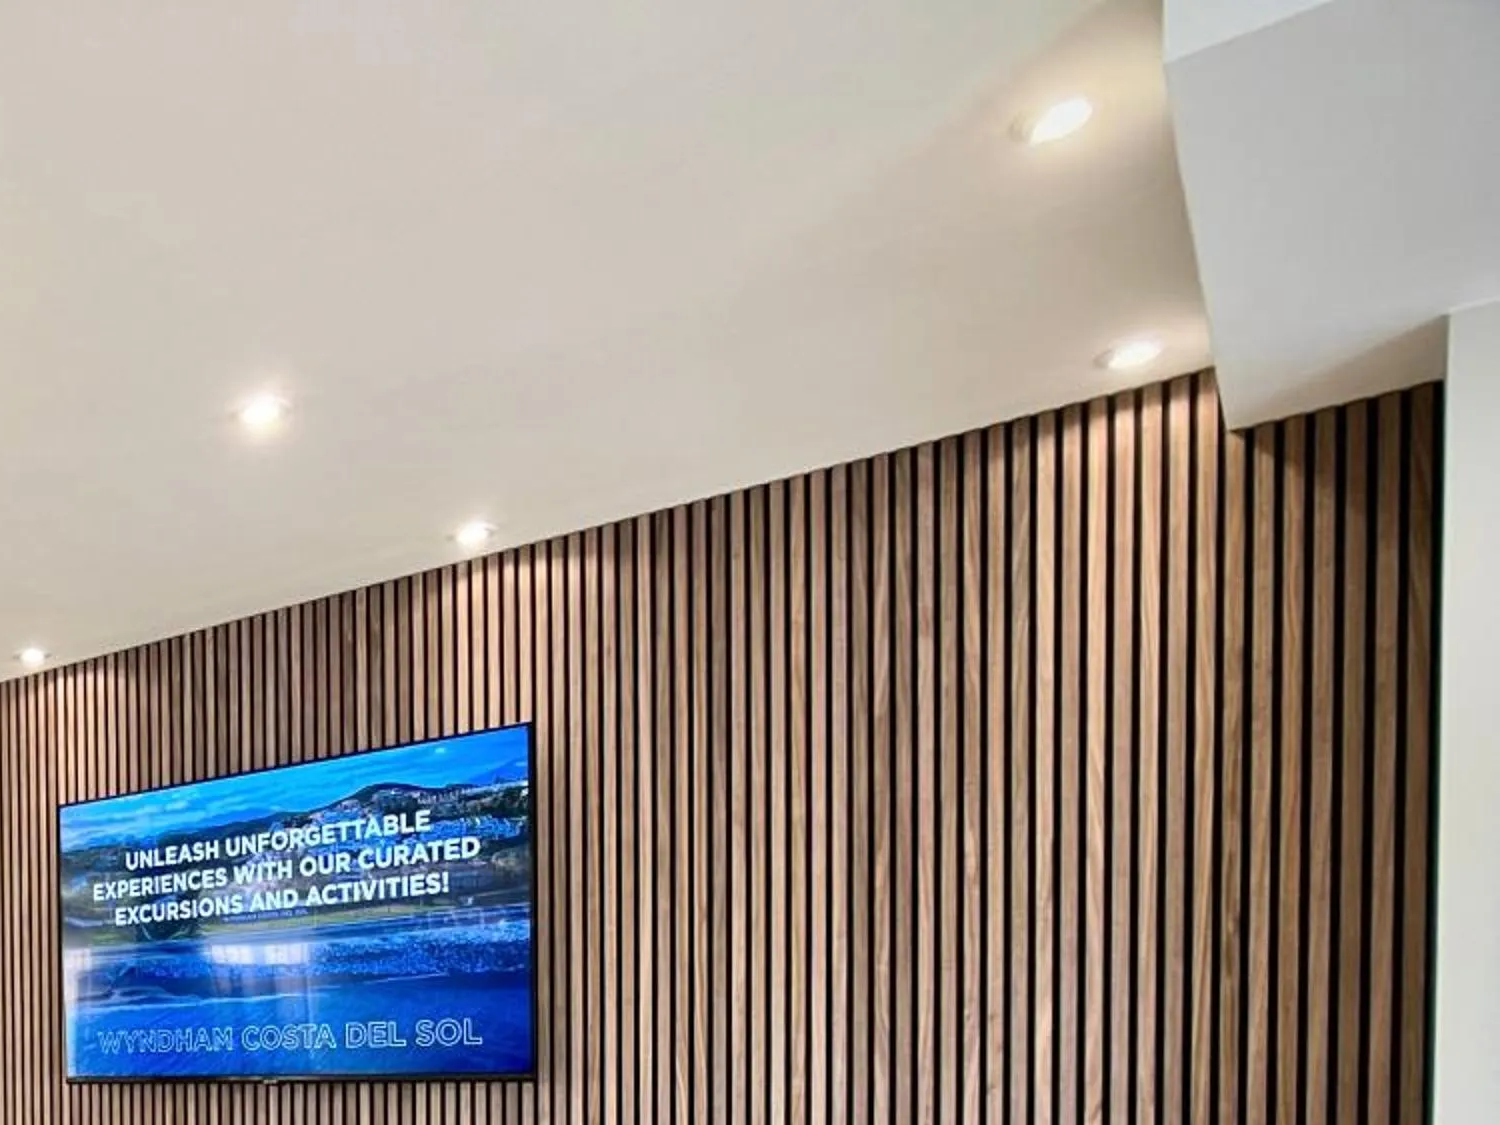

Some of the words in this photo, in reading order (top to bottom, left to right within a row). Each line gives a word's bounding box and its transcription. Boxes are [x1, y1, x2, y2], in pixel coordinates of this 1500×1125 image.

[93, 867, 228, 901] EXPERIENCES
[233, 859, 293, 885] WITH
[300, 852, 351, 877] OUR
[358, 836, 481, 869] CURATED
[125, 839, 219, 871] UNLEASH
[225, 809, 431, 857] UNFORGETTABLE
[115, 895, 243, 926] EXCURSIONS
[249, 889, 299, 912] AND
[306, 871, 449, 906] ACTIVITIES!
[97, 1025, 233, 1055] WYNDHAM
[241, 1023, 337, 1050] COSTA
[345, 1021, 407, 1049] DEL
[415, 1017, 483, 1047] SOL
